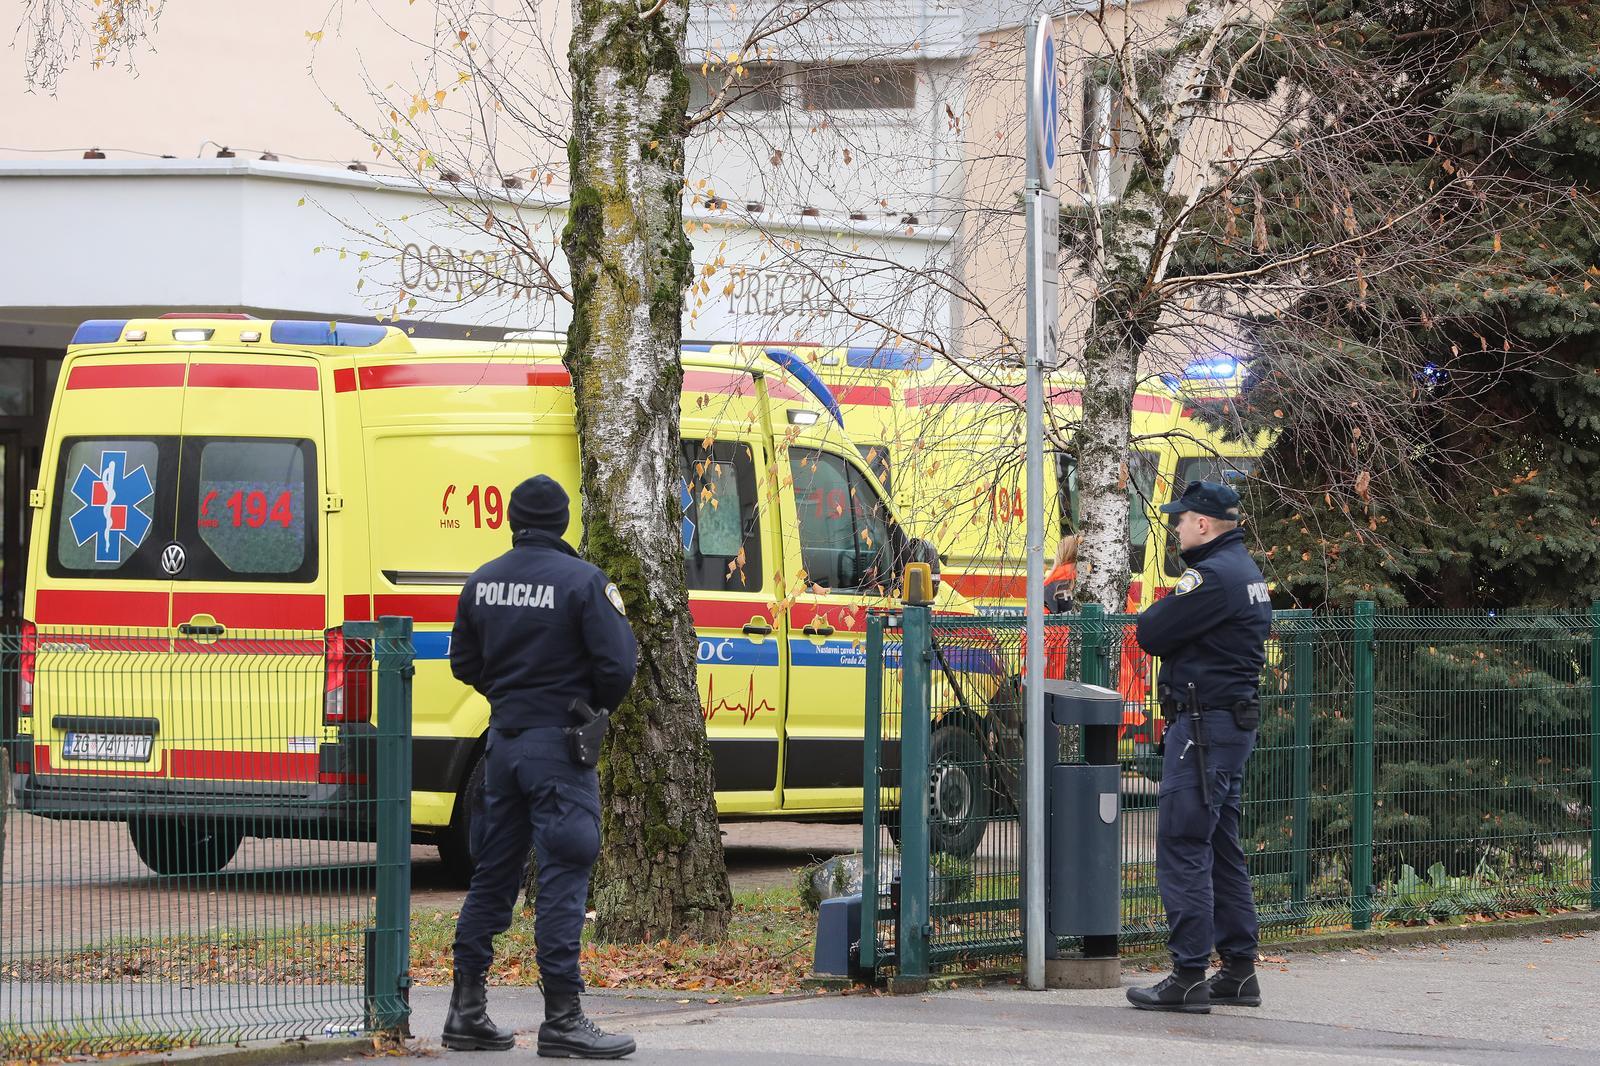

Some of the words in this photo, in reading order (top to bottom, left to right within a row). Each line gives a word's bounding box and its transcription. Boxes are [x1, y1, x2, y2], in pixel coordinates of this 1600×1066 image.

[226, 490, 293, 528] 194
[467, 485, 510, 529] 19
[440, 520, 460, 528] HMS
[475, 582, 555, 609] POLICIJA
[840, 655, 857, 665] Grada
